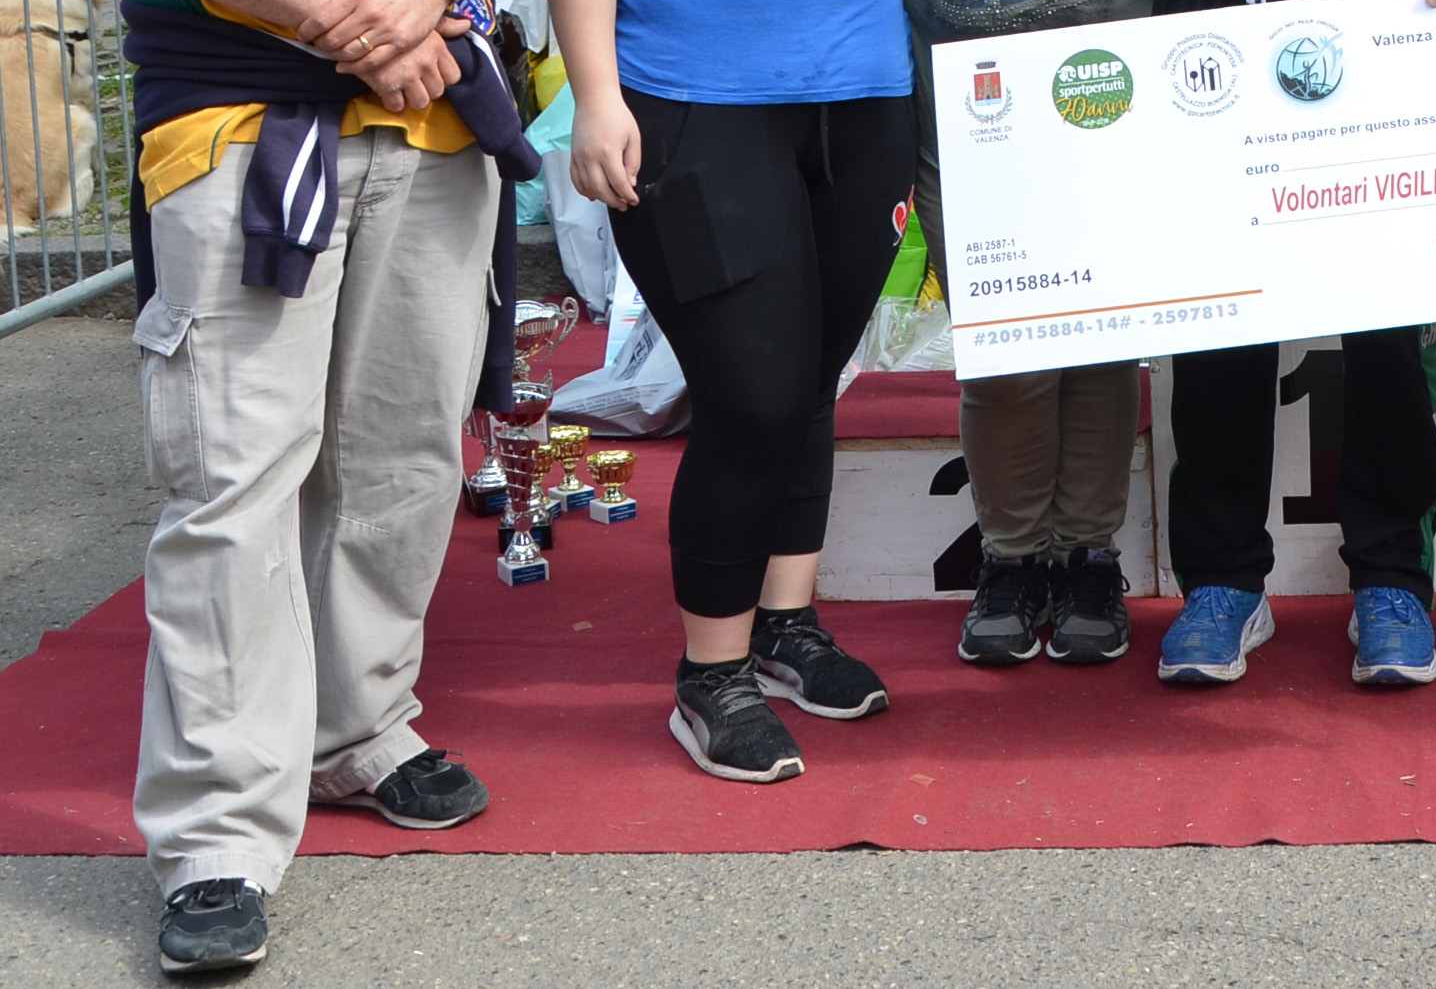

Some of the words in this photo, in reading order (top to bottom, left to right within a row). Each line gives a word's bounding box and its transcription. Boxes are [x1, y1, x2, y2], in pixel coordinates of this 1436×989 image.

[1268, 27, 1283, 40] DICO
[1316, 19, 1339, 33] DROGA
[1372, 29, 1433, 48] Valenza
[1077, 60, 1124, 80] UISP
[1058, 79, 1126, 99] sportpertutti
[969, 127, 1003, 137] COMUNE
[1004, 125, 1013, 133] DI
[974, 134, 1009, 144] VALENZA
[1244, 136, 1254, 146] A
[1256, 131, 1289, 145] vista
[1291, 126, 1337, 143] pagare
[1340, 123, 1362, 137] per
[1365, 117, 1411, 134] questo
[1245, 163, 1280, 176] euro
[1271, 176, 1368, 213] Volontari
[1250, 216, 1259, 227] a
[965, 242, 983, 253] ABI
[984, 238, 1016, 251] 2587-1
[966, 254, 988, 266] CAB
[990, 250, 1027, 264] 56761-5
[969, 268, 1093, 298] 20915884-14
[973, 314, 1133, 347] #20915884-14#
[1152, 302, 1239, 326] 2597813
